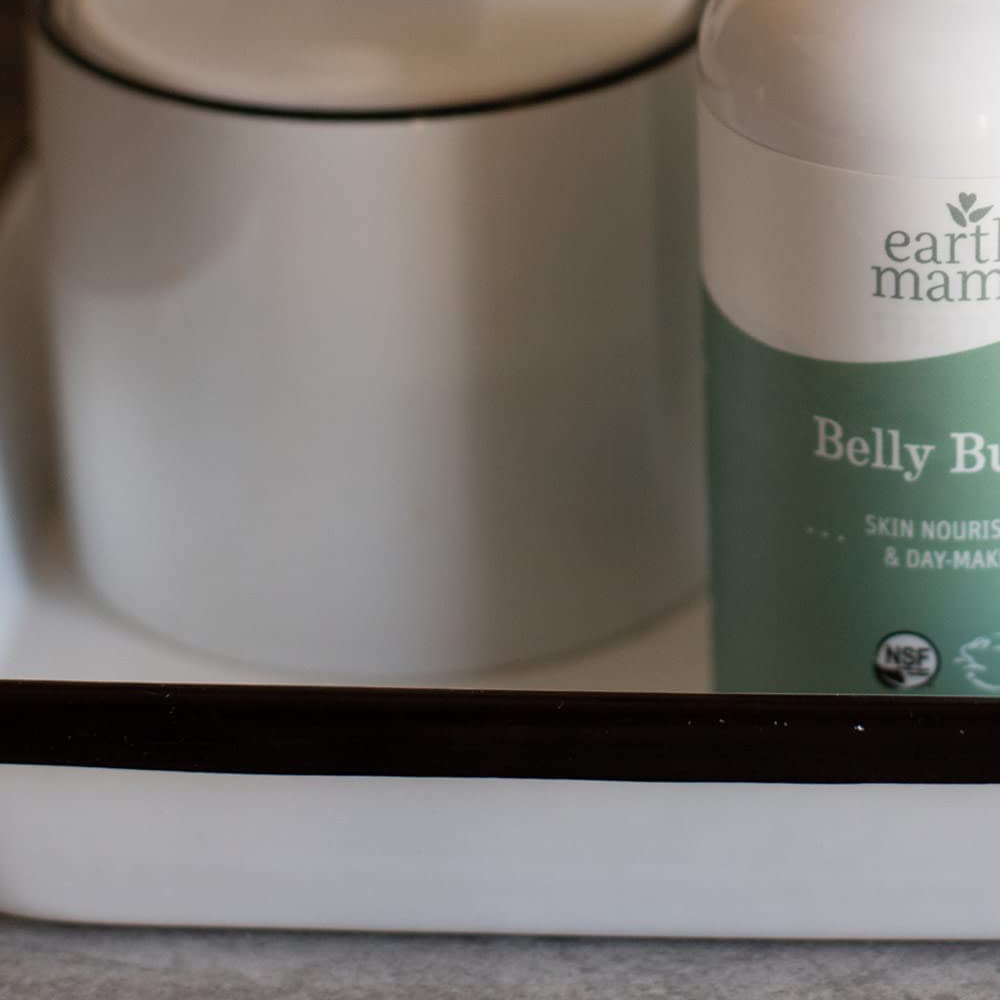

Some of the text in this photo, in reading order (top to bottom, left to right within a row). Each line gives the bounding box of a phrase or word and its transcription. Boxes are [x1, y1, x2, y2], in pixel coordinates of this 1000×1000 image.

[813, 415, 936, 482] Belly
[864, 513, 914, 538] SKIN
[884, 546, 899, 567] &
